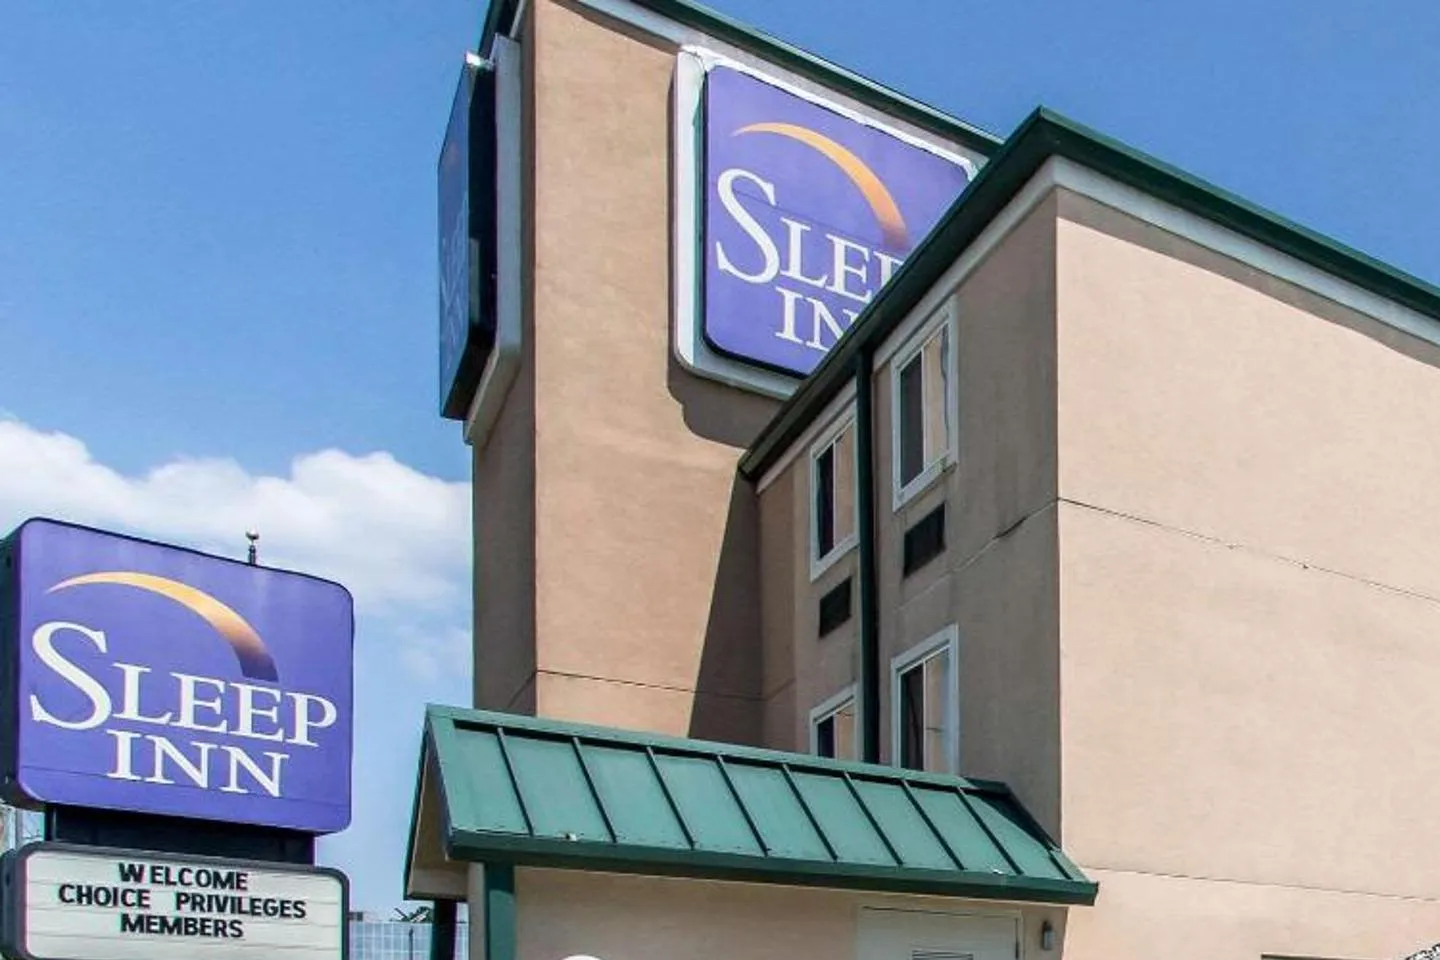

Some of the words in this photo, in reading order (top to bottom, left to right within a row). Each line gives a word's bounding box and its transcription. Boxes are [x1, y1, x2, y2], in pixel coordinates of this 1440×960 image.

[716, 168, 905, 300] SLE
[775, 286, 859, 352] IN
[30, 621, 337, 747] SLEEP
[106, 729, 289, 797] INN
[58, 884, 151, 909] CHOICE
[175, 892, 307, 919] PRIVILEGES
[118, 863, 248, 890] WELCOME
[120, 914, 244, 938] MEMBERS
